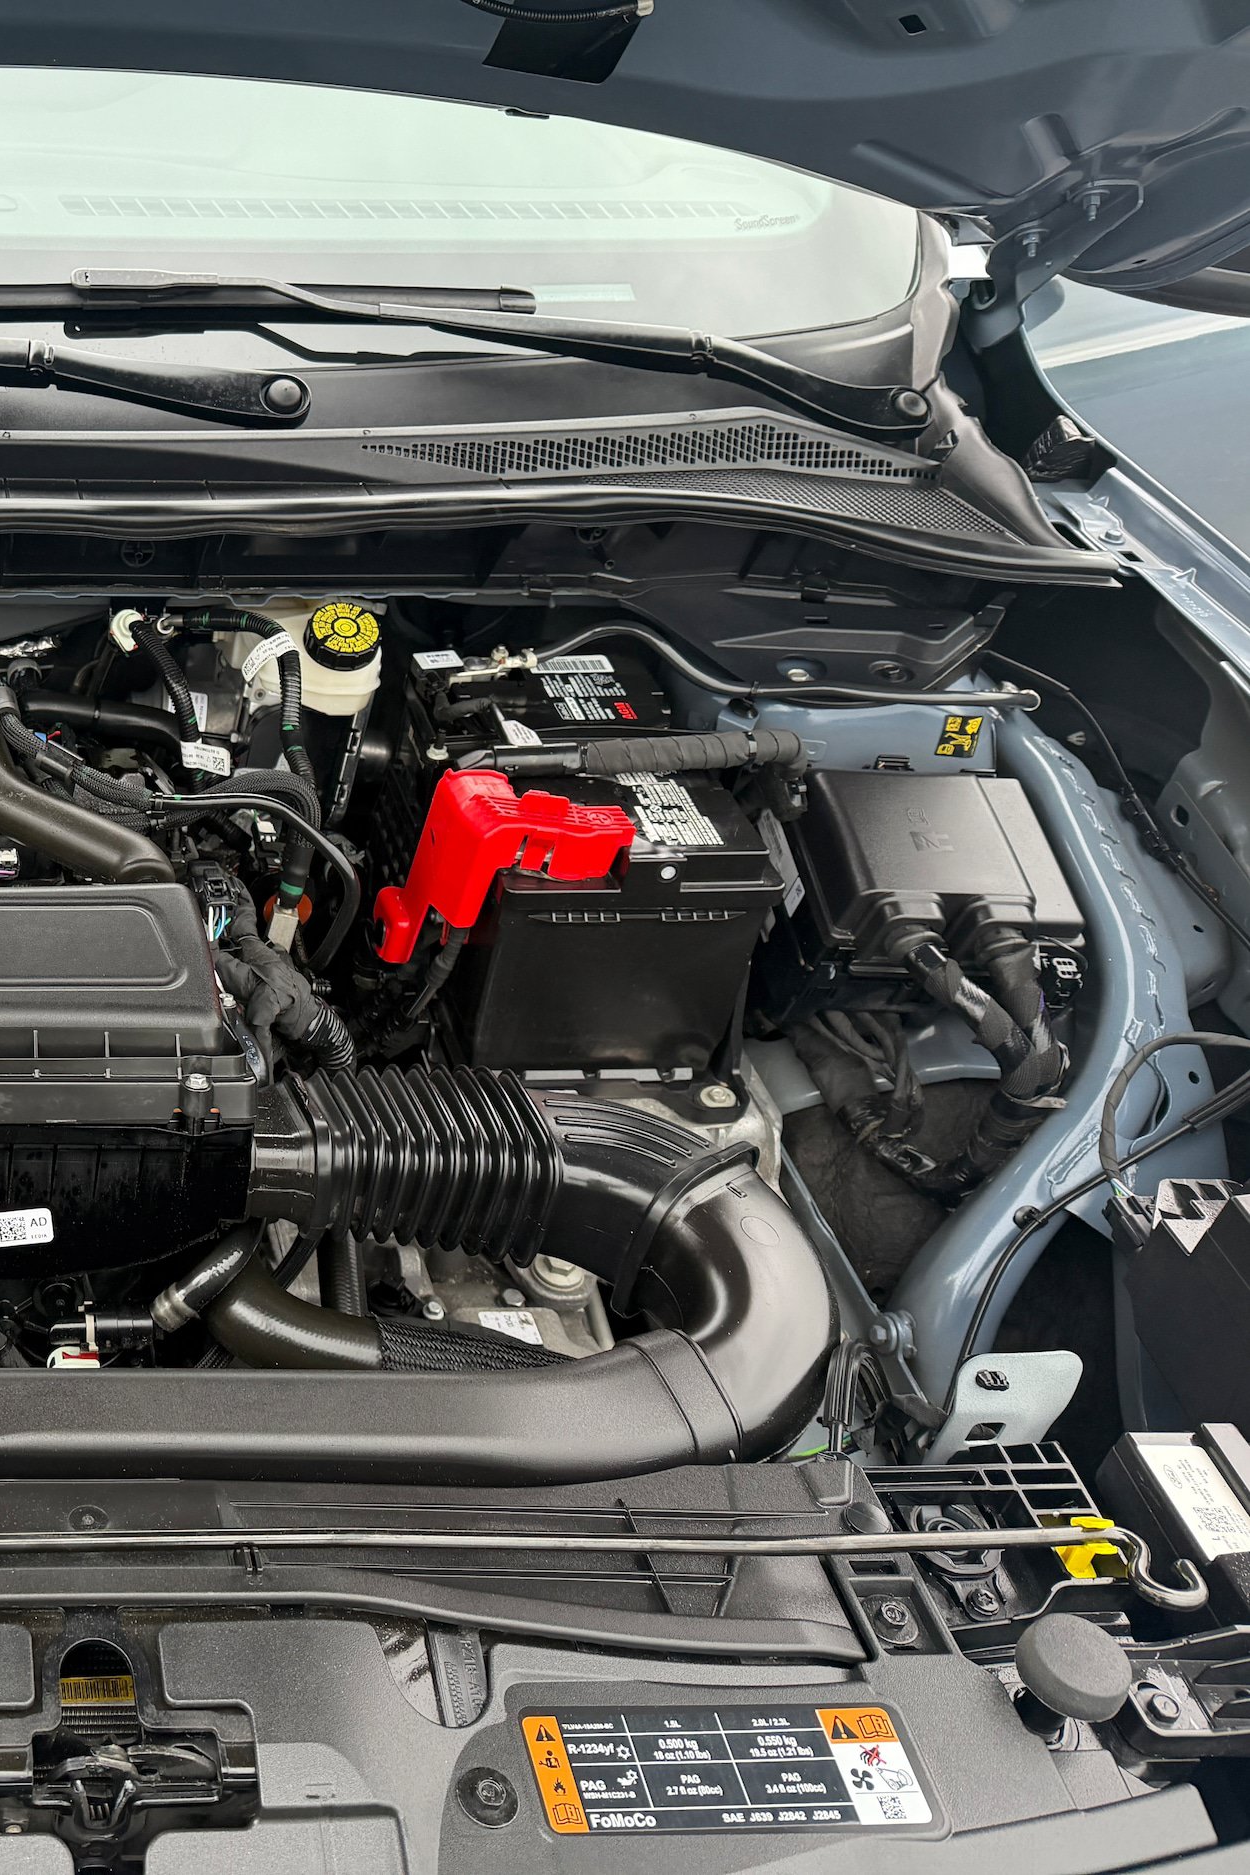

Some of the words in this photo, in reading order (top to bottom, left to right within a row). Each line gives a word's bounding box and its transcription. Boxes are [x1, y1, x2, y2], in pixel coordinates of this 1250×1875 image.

[734, 214, 797, 230] SoundScreen
[30, 1216, 48, 1228] AD
[664, 1720, 682, 1729] 1.5L
[658, 1738, 684, 1750] 0.500
[684, 1738, 699, 1751] kg
[757, 1735, 783, 1746] 0.550
[783, 1735, 798, 1747] kg
[567, 1743, 615, 1756] R-1234yf
[664, 1752, 675, 1760] oz
[675, 1750, 695, 1760] (1.10
[695, 1749, 711, 1760] lbs)
[750, 1748, 767, 1757] 19.5
[767, 1749, 778, 1757] oz
[778, 1747, 797, 1758] (1.21
[797, 1746, 814, 1758] lbs)
[680, 1774, 701, 1784] PAG
[781, 1772, 802, 1782] PAG
[580, 1780, 607, 1791] PAG
[666, 1786, 679, 1796] 2.7
[687, 1787, 698, 1796] oz
[698, 1785, 723, 1796] (80cc)
[765, 1784, 778, 1794] 3.4
[786, 1785, 797, 1793] oz
[797, 1782, 827, 1794] (100cc)
[589, 1812, 657, 1828] FoMoCo
[722, 1812, 746, 1823] SAE
[750, 1812, 774, 1822] J639
[778, 1811, 807, 1821] J2842
[813, 1810, 842, 1821] J2845
